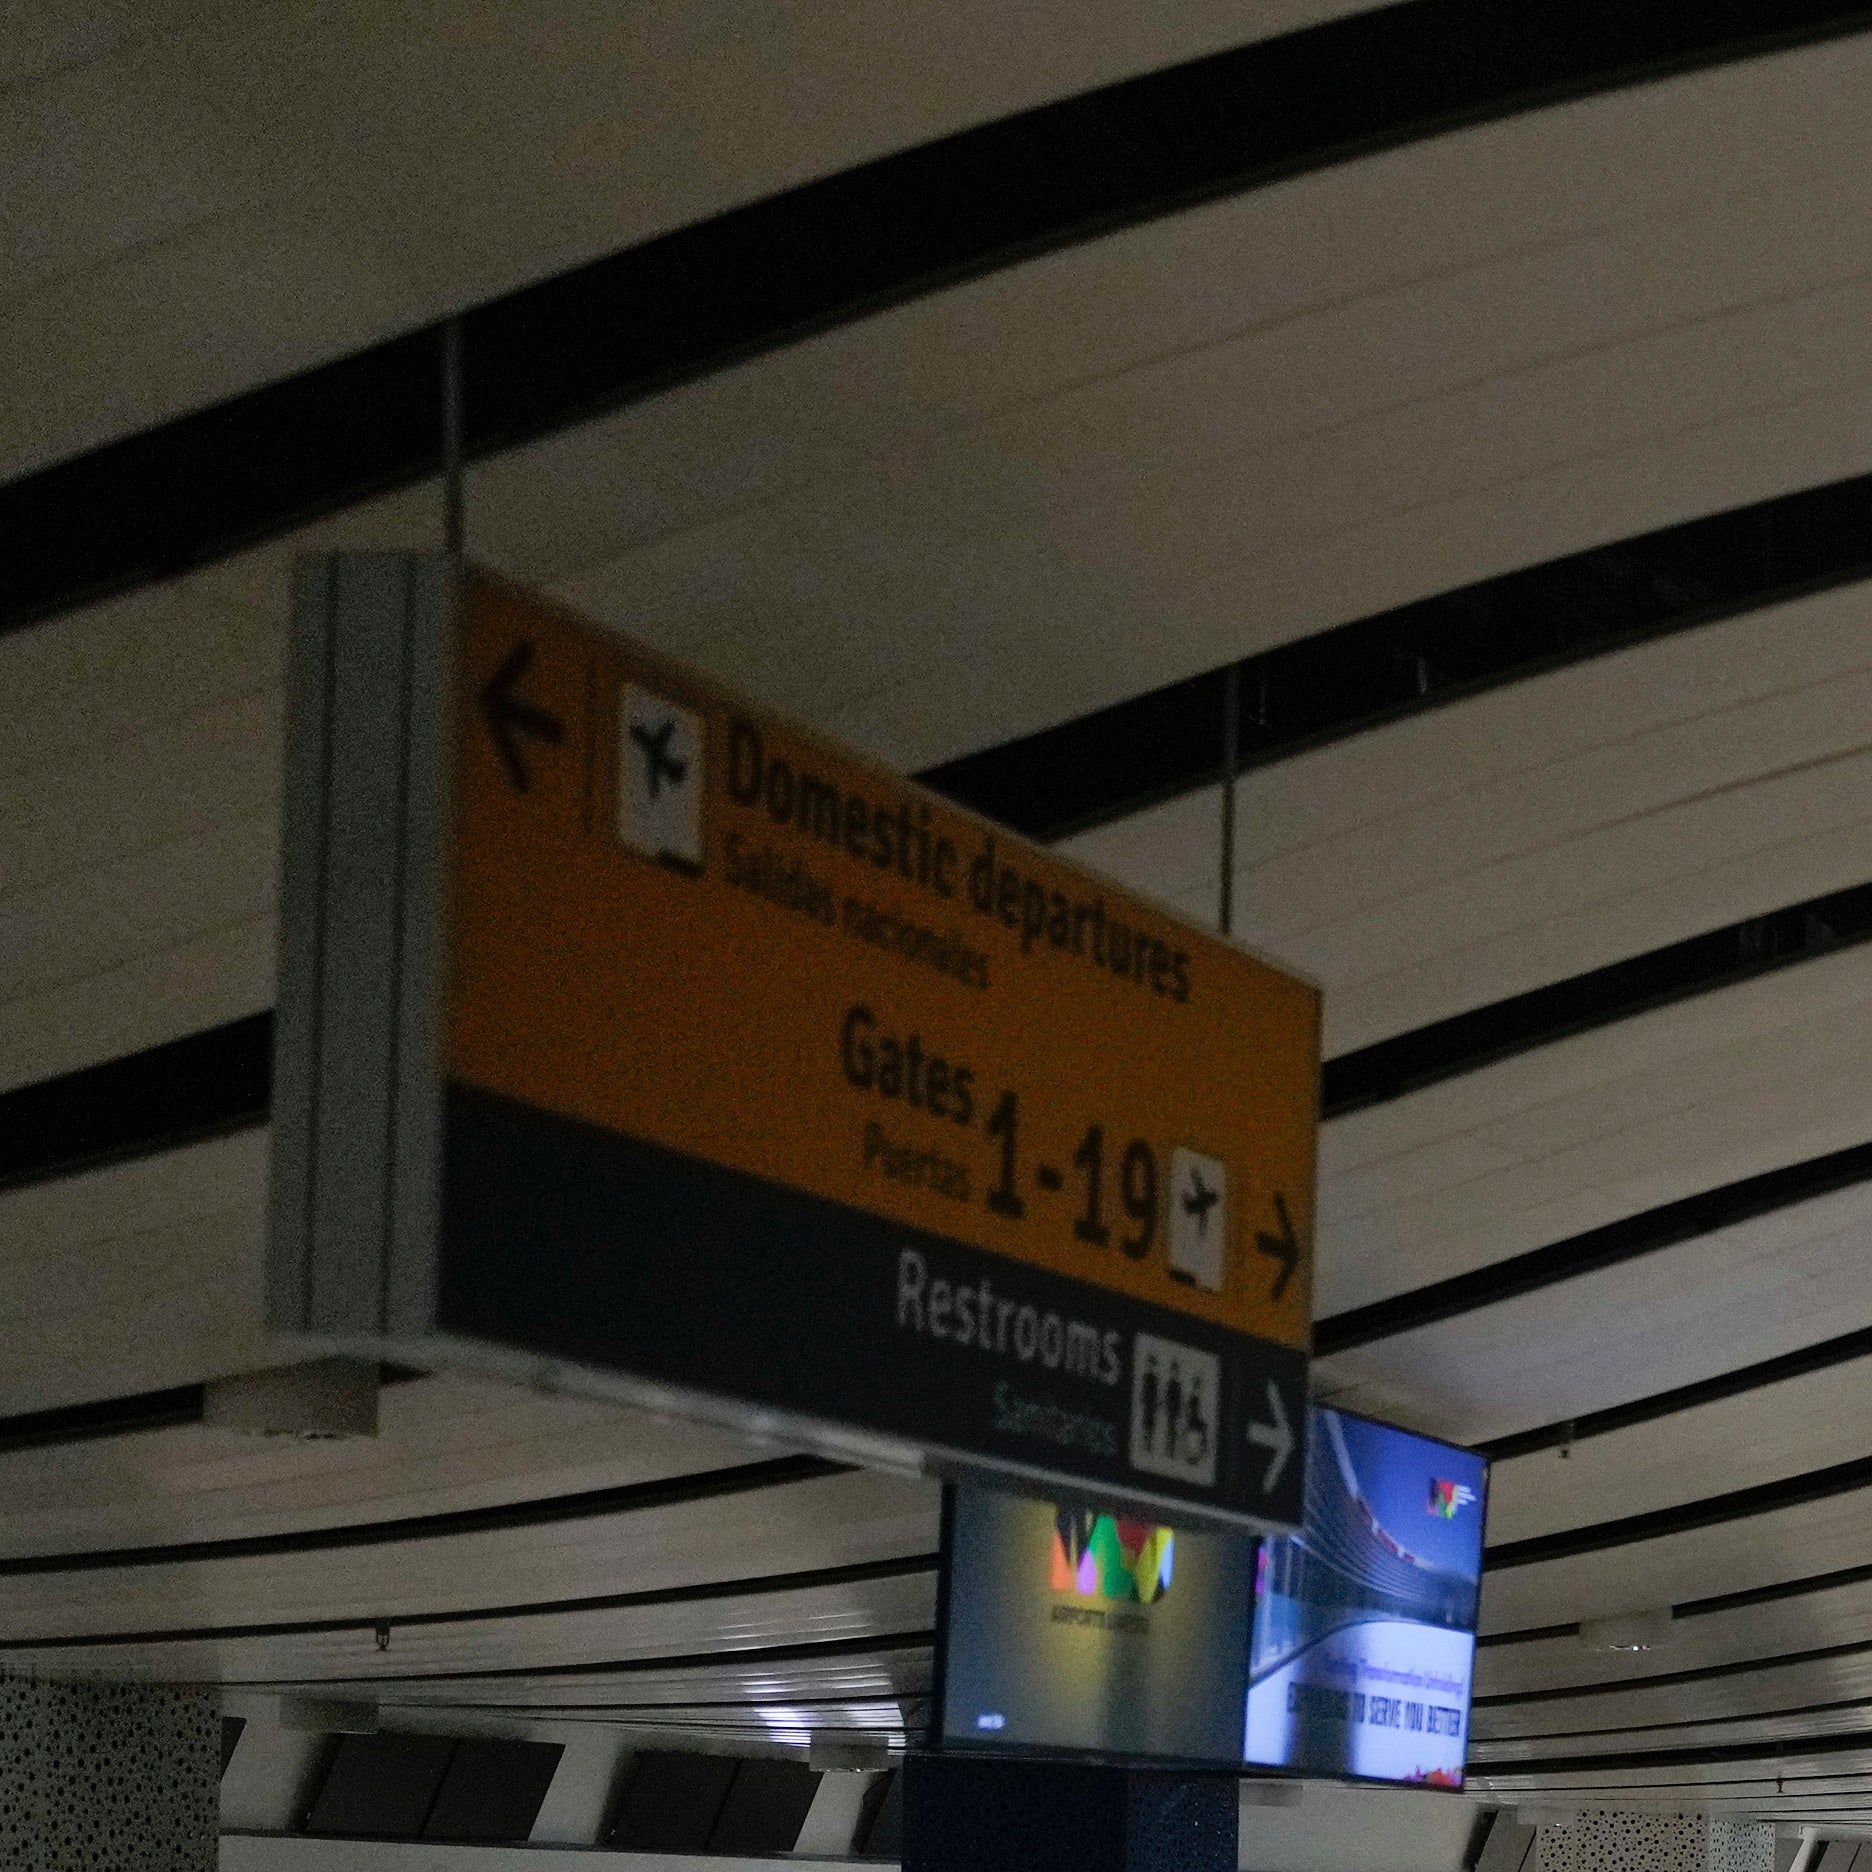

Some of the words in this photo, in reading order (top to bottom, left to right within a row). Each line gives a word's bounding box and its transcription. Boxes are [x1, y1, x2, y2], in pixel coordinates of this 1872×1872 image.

[725, 718, 955, 900] Domestic
[967, 834, 1190, 1003] departures
[840, 1004, 973, 1128] Gates
[985, 1088, 1158, 1261] 1-19
[896, 1246, 1121, 1387] Restrooms
[1369, 1695, 1401, 1729] SERVE
[1404, 1700, 1424, 1733] YOU
[1427, 1704, 1461, 1738] BETTER
